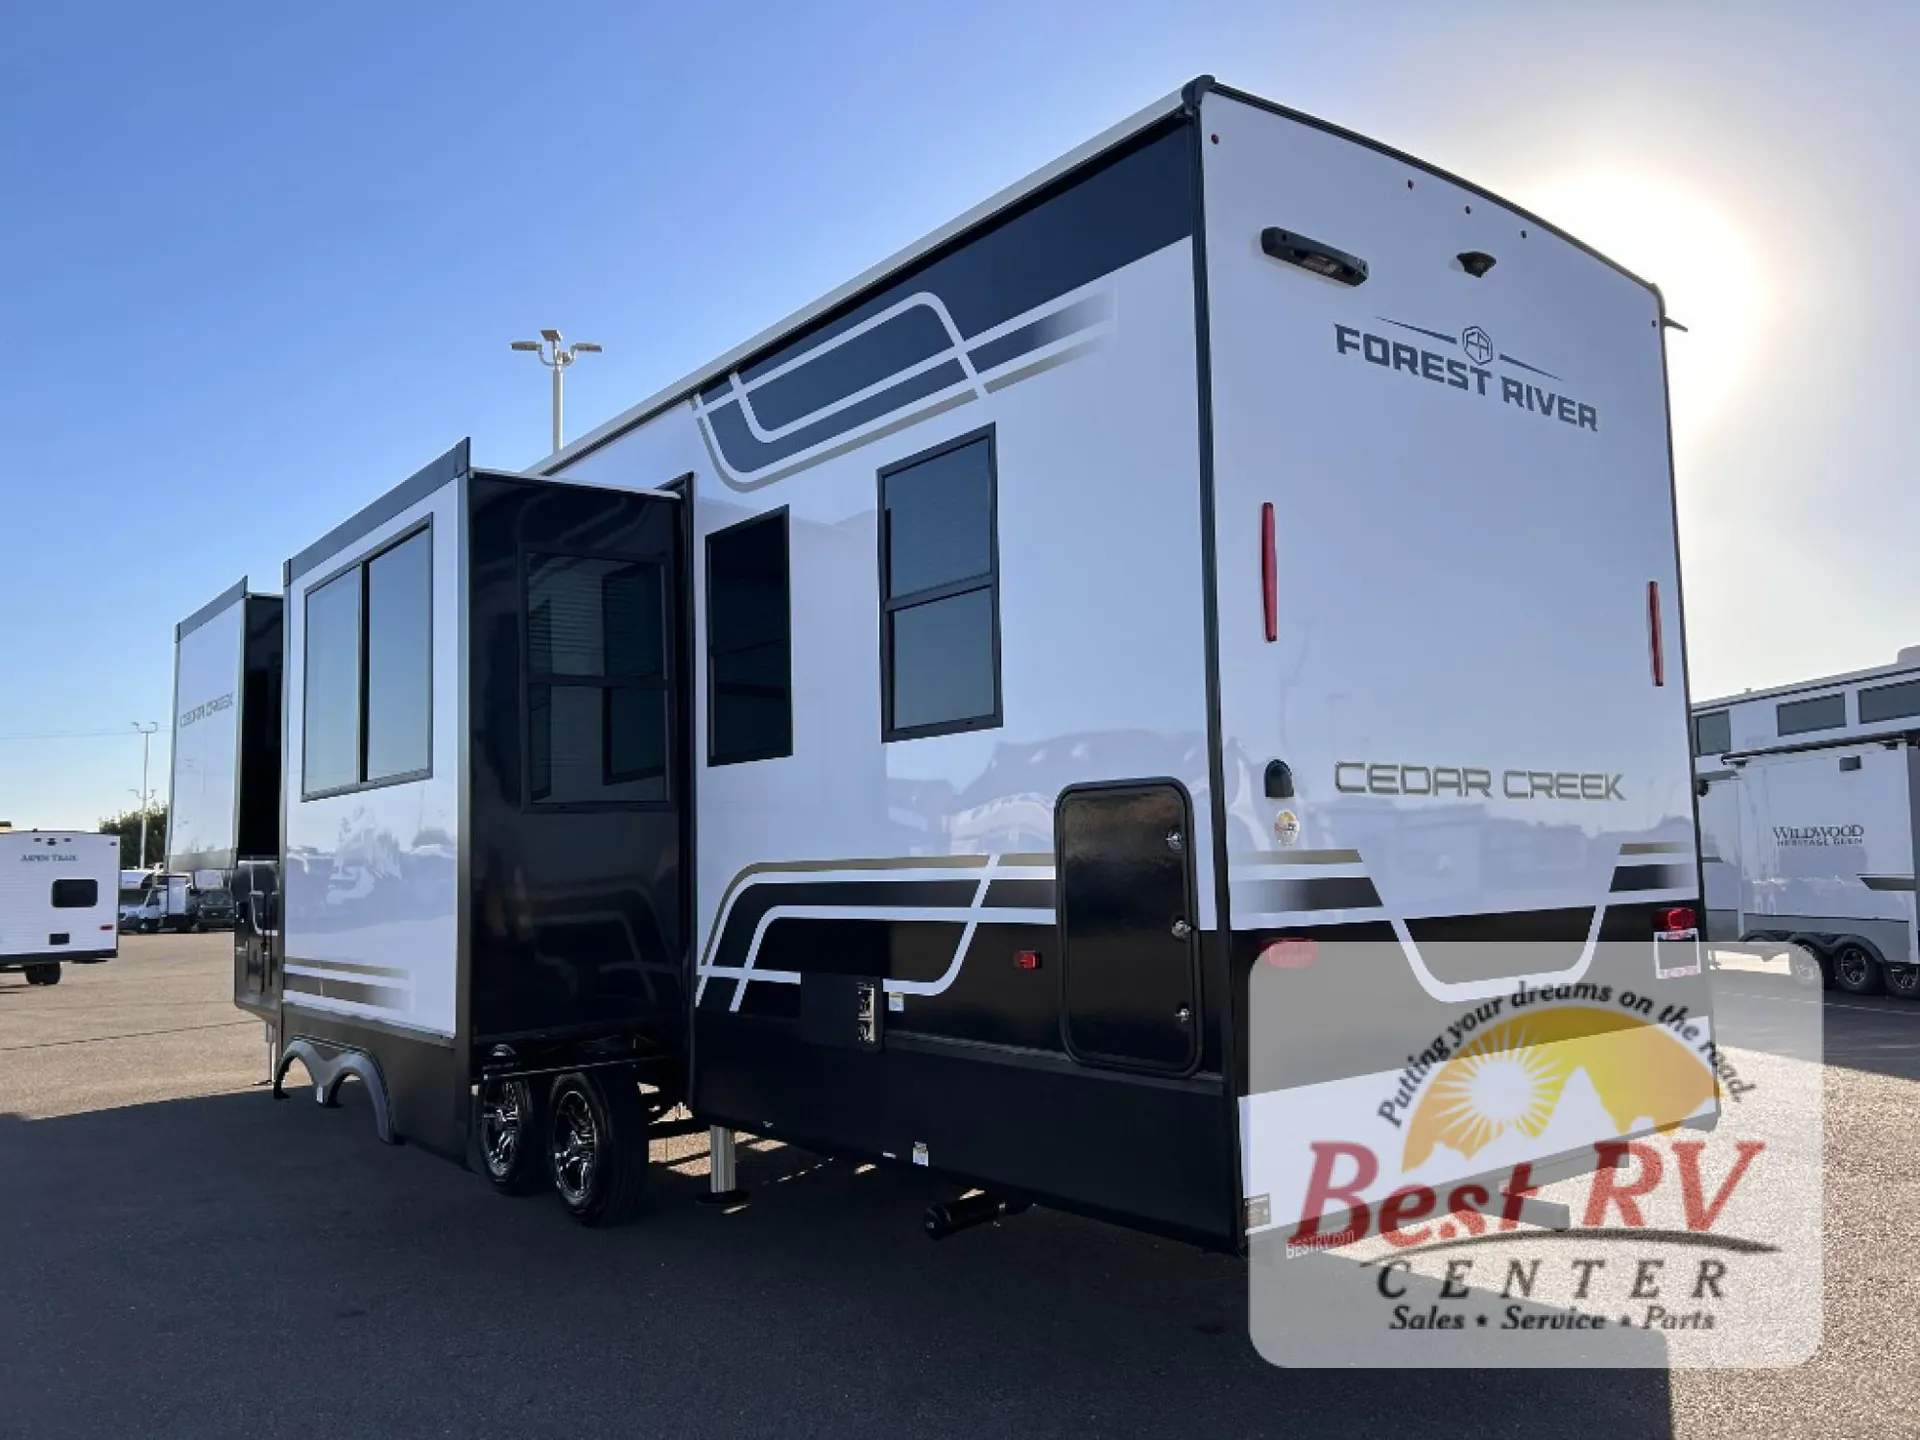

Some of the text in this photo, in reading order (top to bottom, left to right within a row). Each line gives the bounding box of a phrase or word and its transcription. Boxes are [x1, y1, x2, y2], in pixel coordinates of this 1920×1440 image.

[1333, 322, 1598, 432] FOREST RIVER
[1334, 760, 1628, 801] CEDAR CREEK
[1772, 824, 1865, 839] WILDWOOD
[20, 853, 79, 862] ASPEN TRAIL
